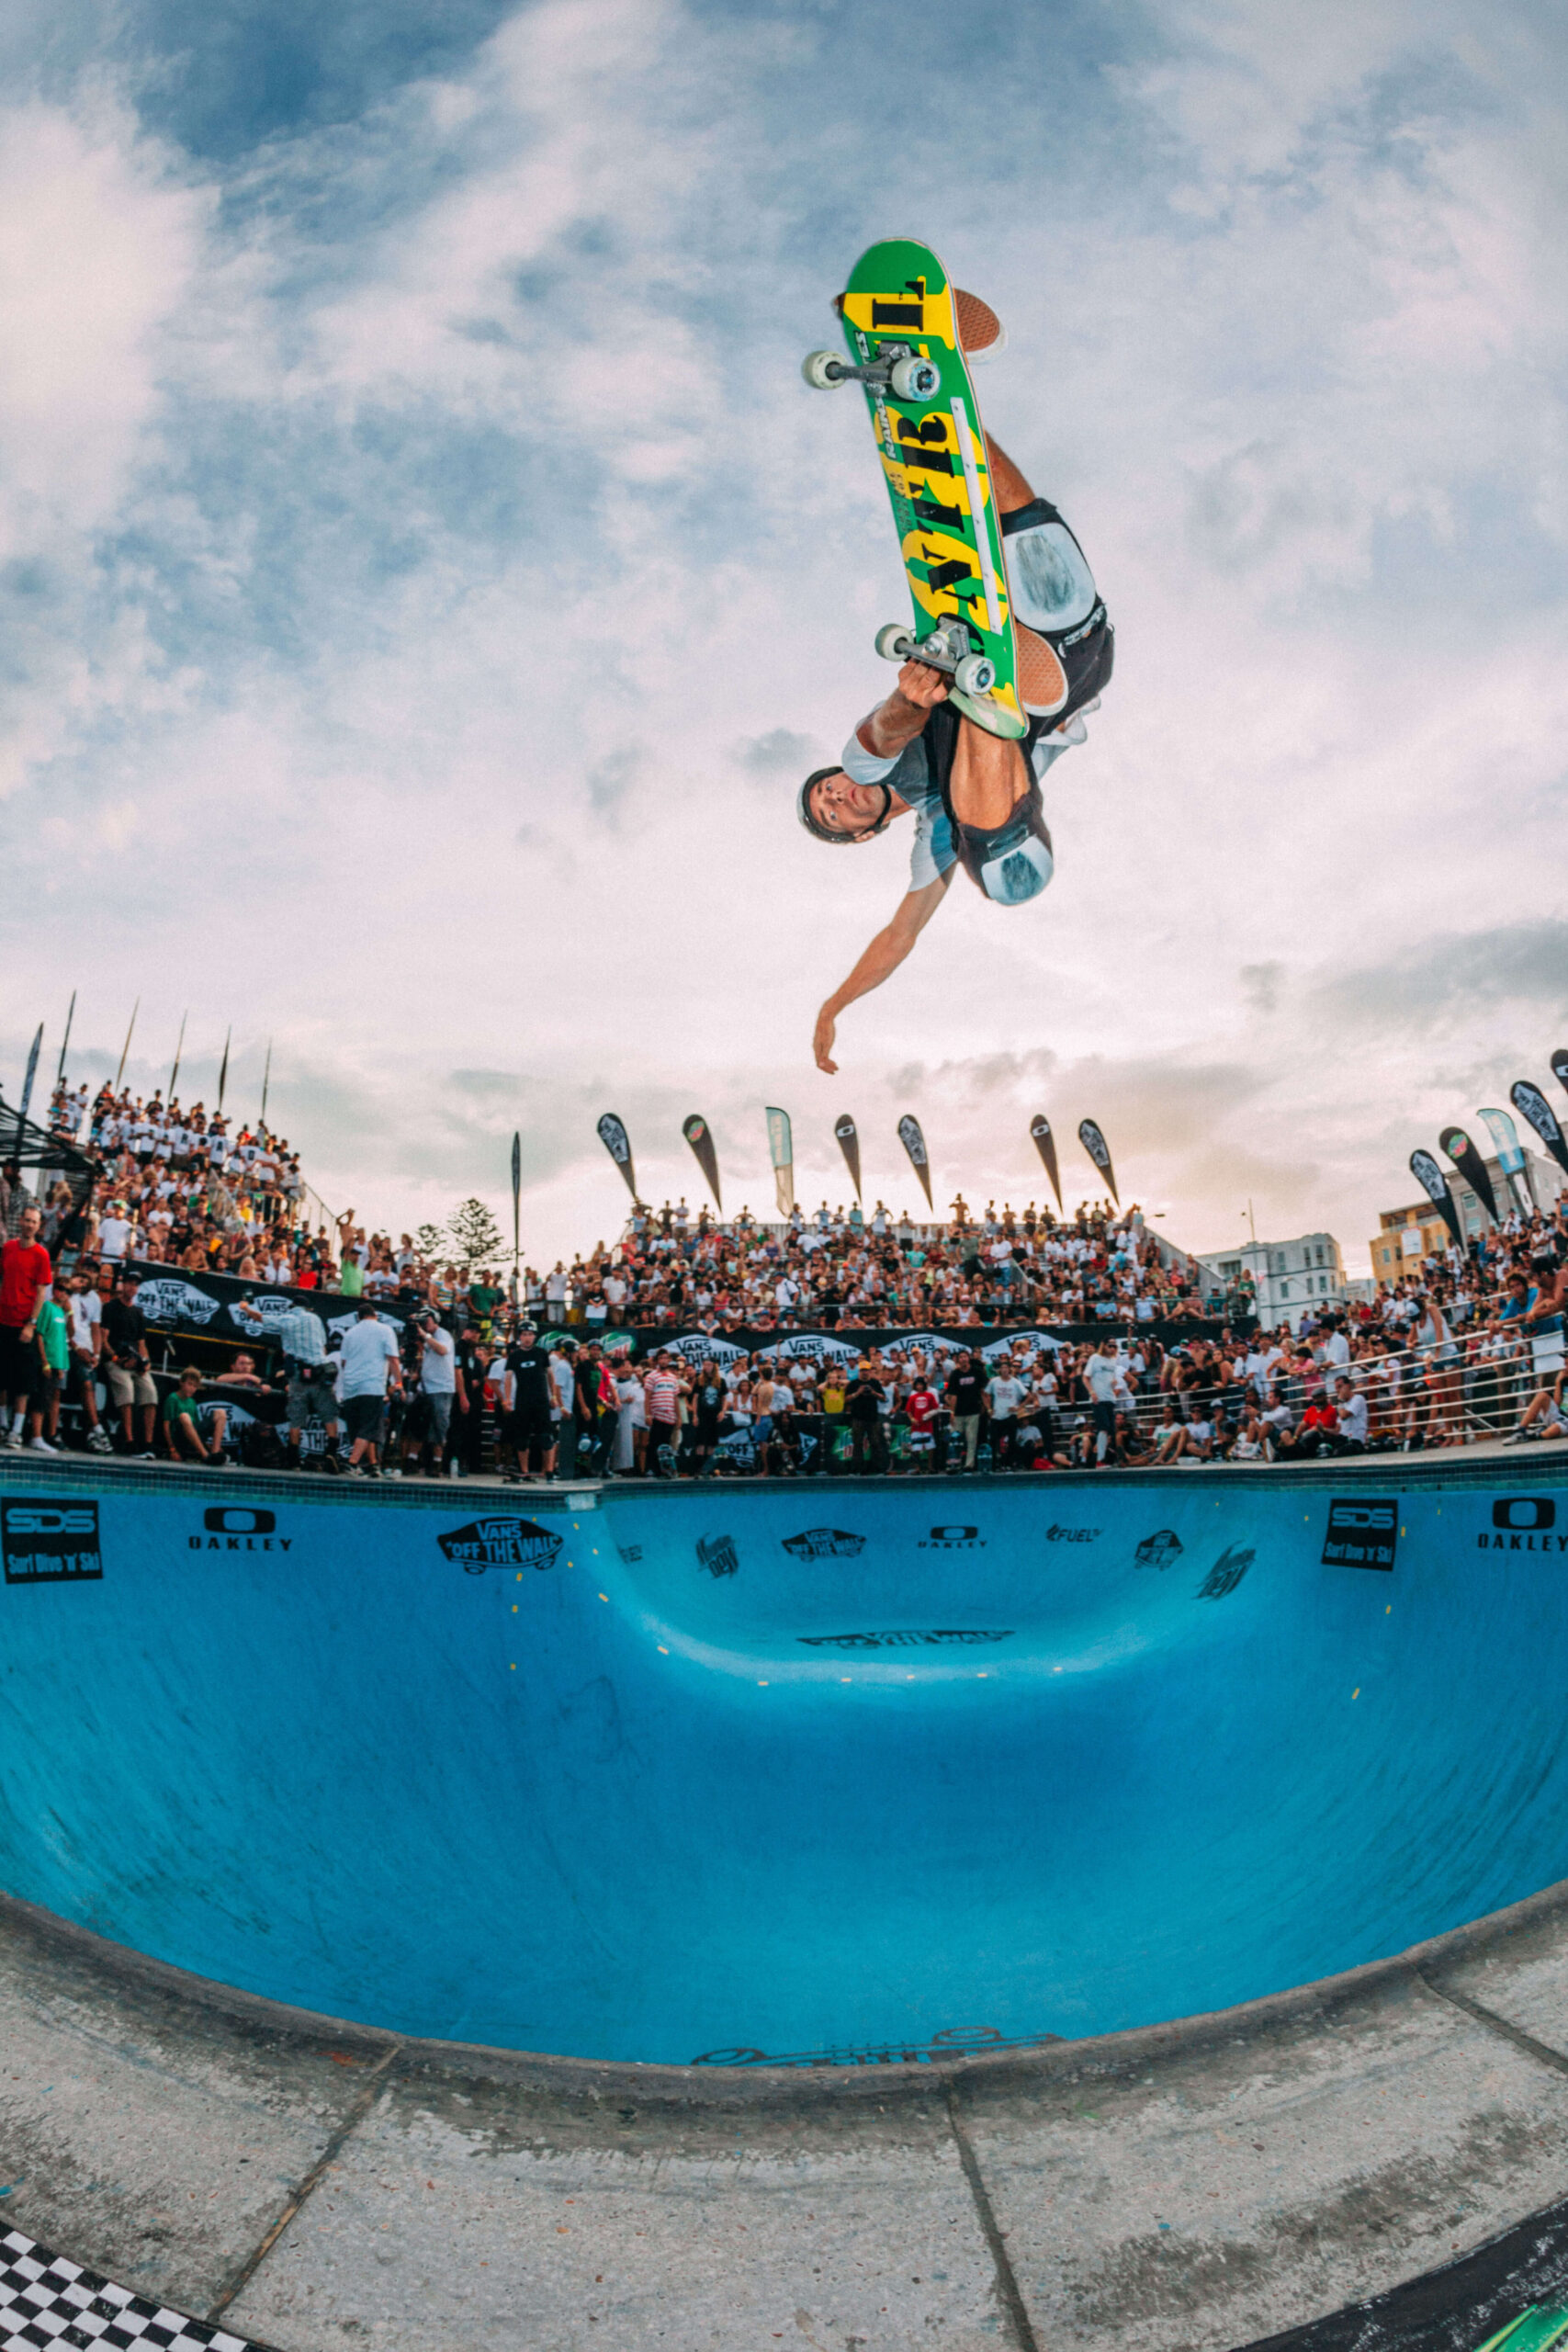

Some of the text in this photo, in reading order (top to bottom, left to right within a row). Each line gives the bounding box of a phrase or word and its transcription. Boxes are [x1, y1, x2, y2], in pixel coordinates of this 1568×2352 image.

[155, 1280, 186, 1297] VANS
[257, 1299, 288, 1312] VANS
[676, 1339, 712, 1352] VANS
[788, 1339, 825, 1352] VANS
[6, 1508, 96, 1533] SDS
[1332, 1507, 1394, 1529] SDS
[476, 1520, 523, 1541] VANS
[189, 1536, 292, 1552] OAKLEY
[482, 1539, 517, 1562] THE
[918, 1541, 987, 1549] OAKLEY
[1478, 1533, 1568, 1552] OAKLEY
